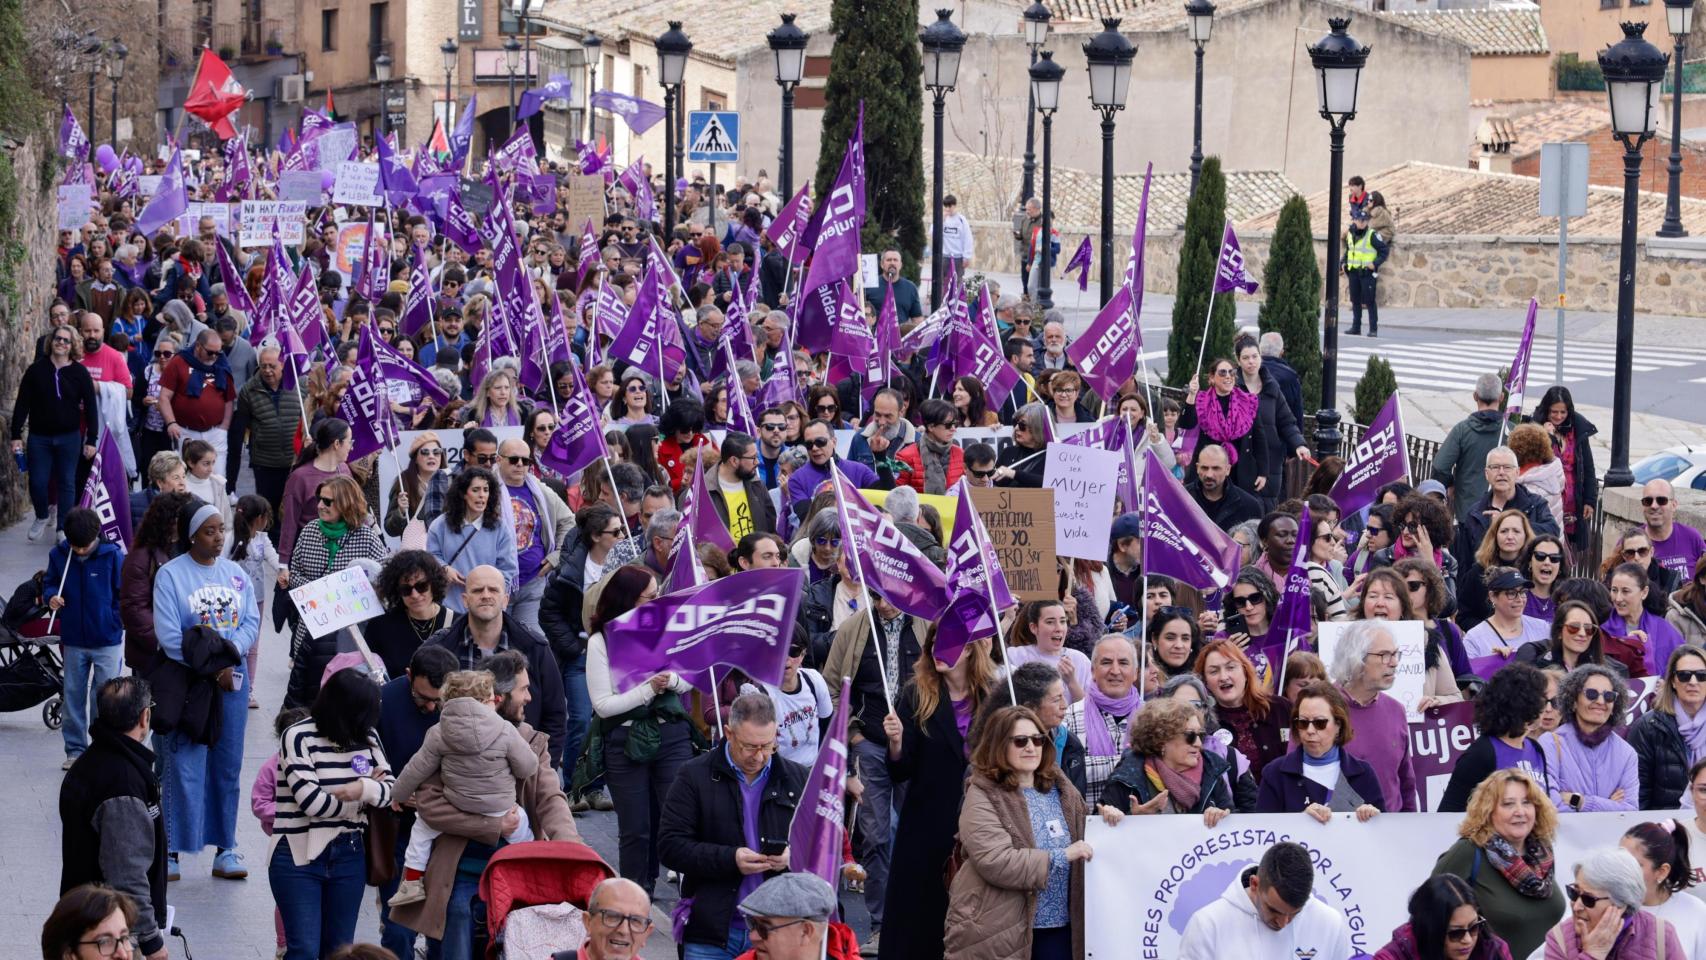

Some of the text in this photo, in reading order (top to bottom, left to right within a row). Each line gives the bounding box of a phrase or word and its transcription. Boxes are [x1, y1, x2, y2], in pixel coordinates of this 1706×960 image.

[874, 550, 910, 571] Obreras
[879, 562, 915, 583] Mancha
[1408, 718, 1481, 764] ujer
[1142, 908, 1163, 960] ERES
[1154, 829, 1290, 904] PROGRESISTAS
[1329, 872, 1353, 902] LA
[1344, 904, 1367, 958] IGUA
